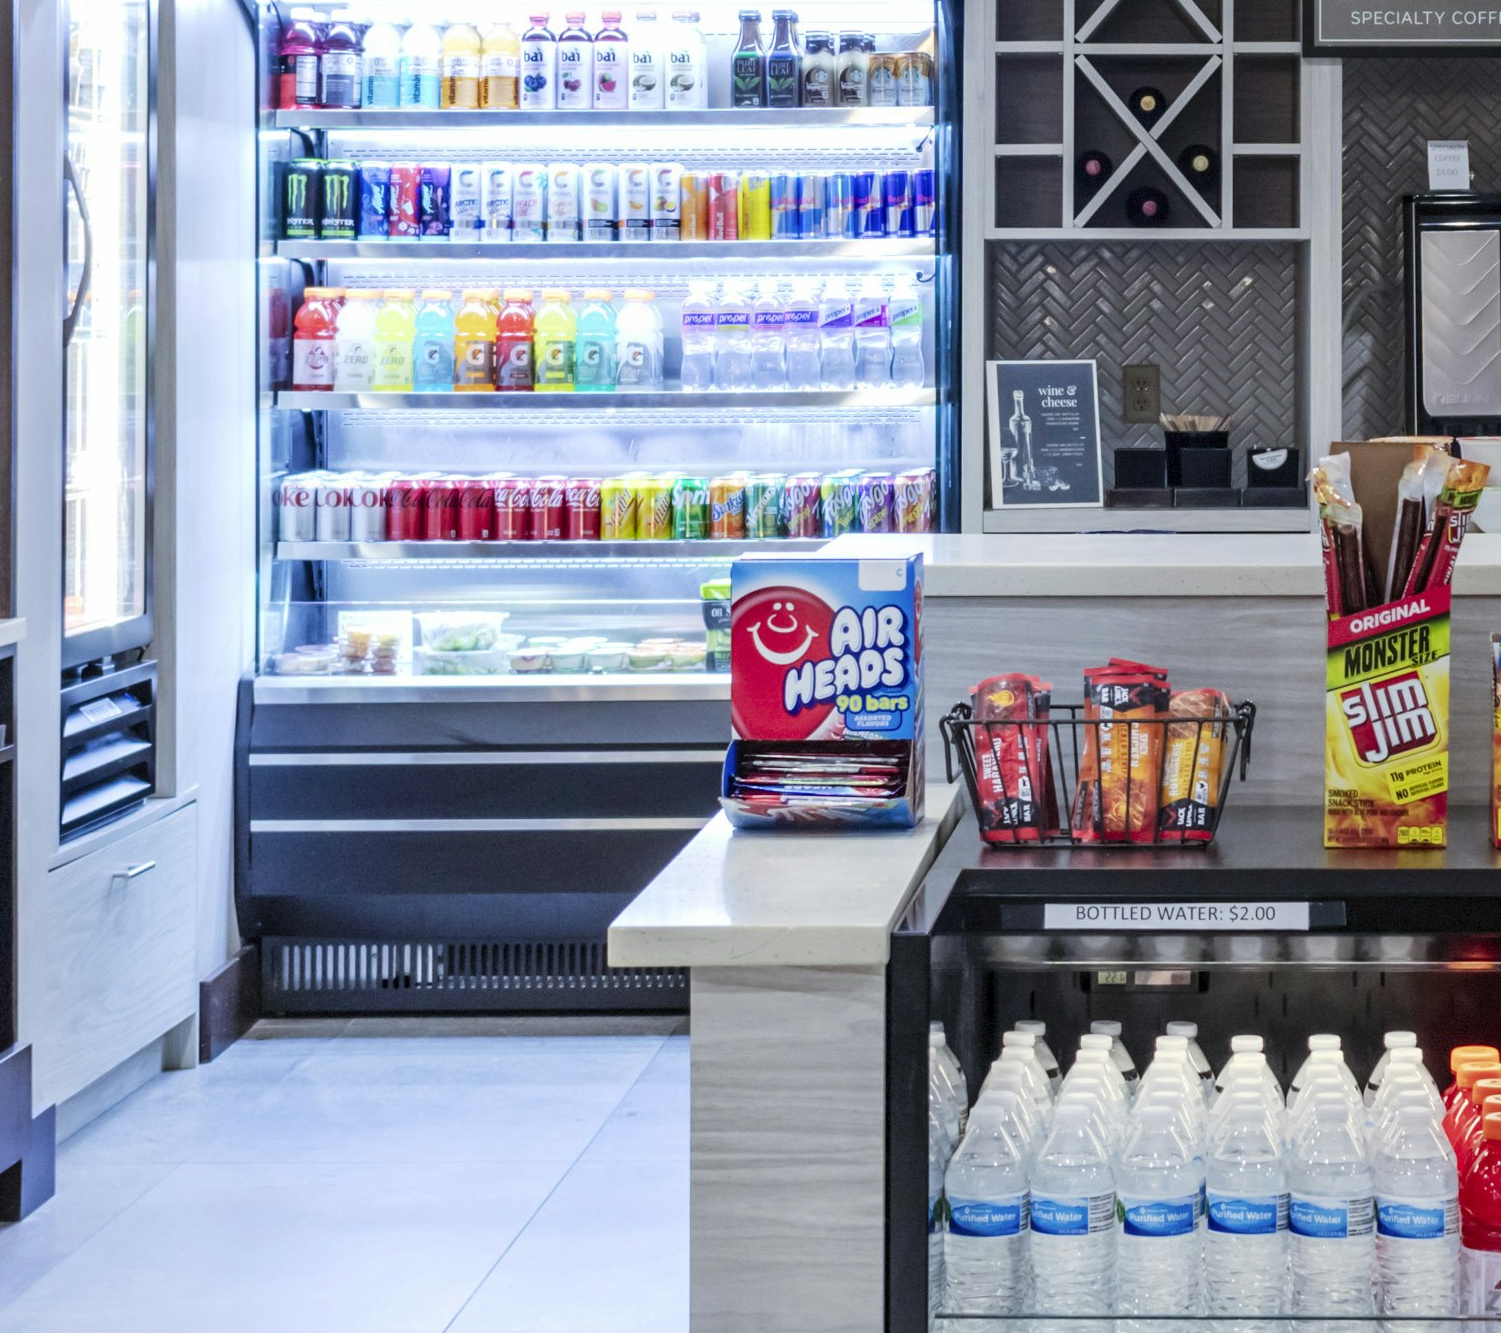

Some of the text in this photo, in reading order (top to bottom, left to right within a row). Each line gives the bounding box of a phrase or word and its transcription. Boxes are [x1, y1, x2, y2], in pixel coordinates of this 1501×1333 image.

[1350, 10, 1444, 26] SPECIALTY
[684, 313, 713, 324] propel
[719, 313, 746, 324] propel
[1038, 385, 1077, 396] wine &
[1041, 396, 1078, 408] cheese
[1349, 598, 1431, 634] ORIGINAL
[831, 606, 905, 657] AIR
[1344, 625, 1431, 678] MONSTER
[1411, 648, 1440, 667] SIZE
[784, 647, 905, 712] HEADS
[837, 695, 909, 713] 90 bars
[1342, 677, 1429, 730] slim
[1364, 706, 1437, 764] jim
[1139, 733, 1149, 755] SPICY
[981, 754, 992, 780] SWEET
[1390, 760, 1442, 782] 11g PROTEIN
[1328, 789, 1359, 798] SMOKED
[1396, 788, 1409, 800] NO
[1023, 804, 1032, 822] BAR
[1198, 807, 1206, 826] BAR
[1076, 905, 1276, 922] BOTTLED WATER: $2.00
[955, 1211, 1016, 1223] Purified Water
[1056, 1212, 1083, 1222] Water
[1129, 1210, 1189, 1223] Purified Water
[1211, 1209, 1272, 1221] Purified Water
[1315, 1214, 1341, 1224] Water
[1380, 1211, 1439, 1225] Purified Water
